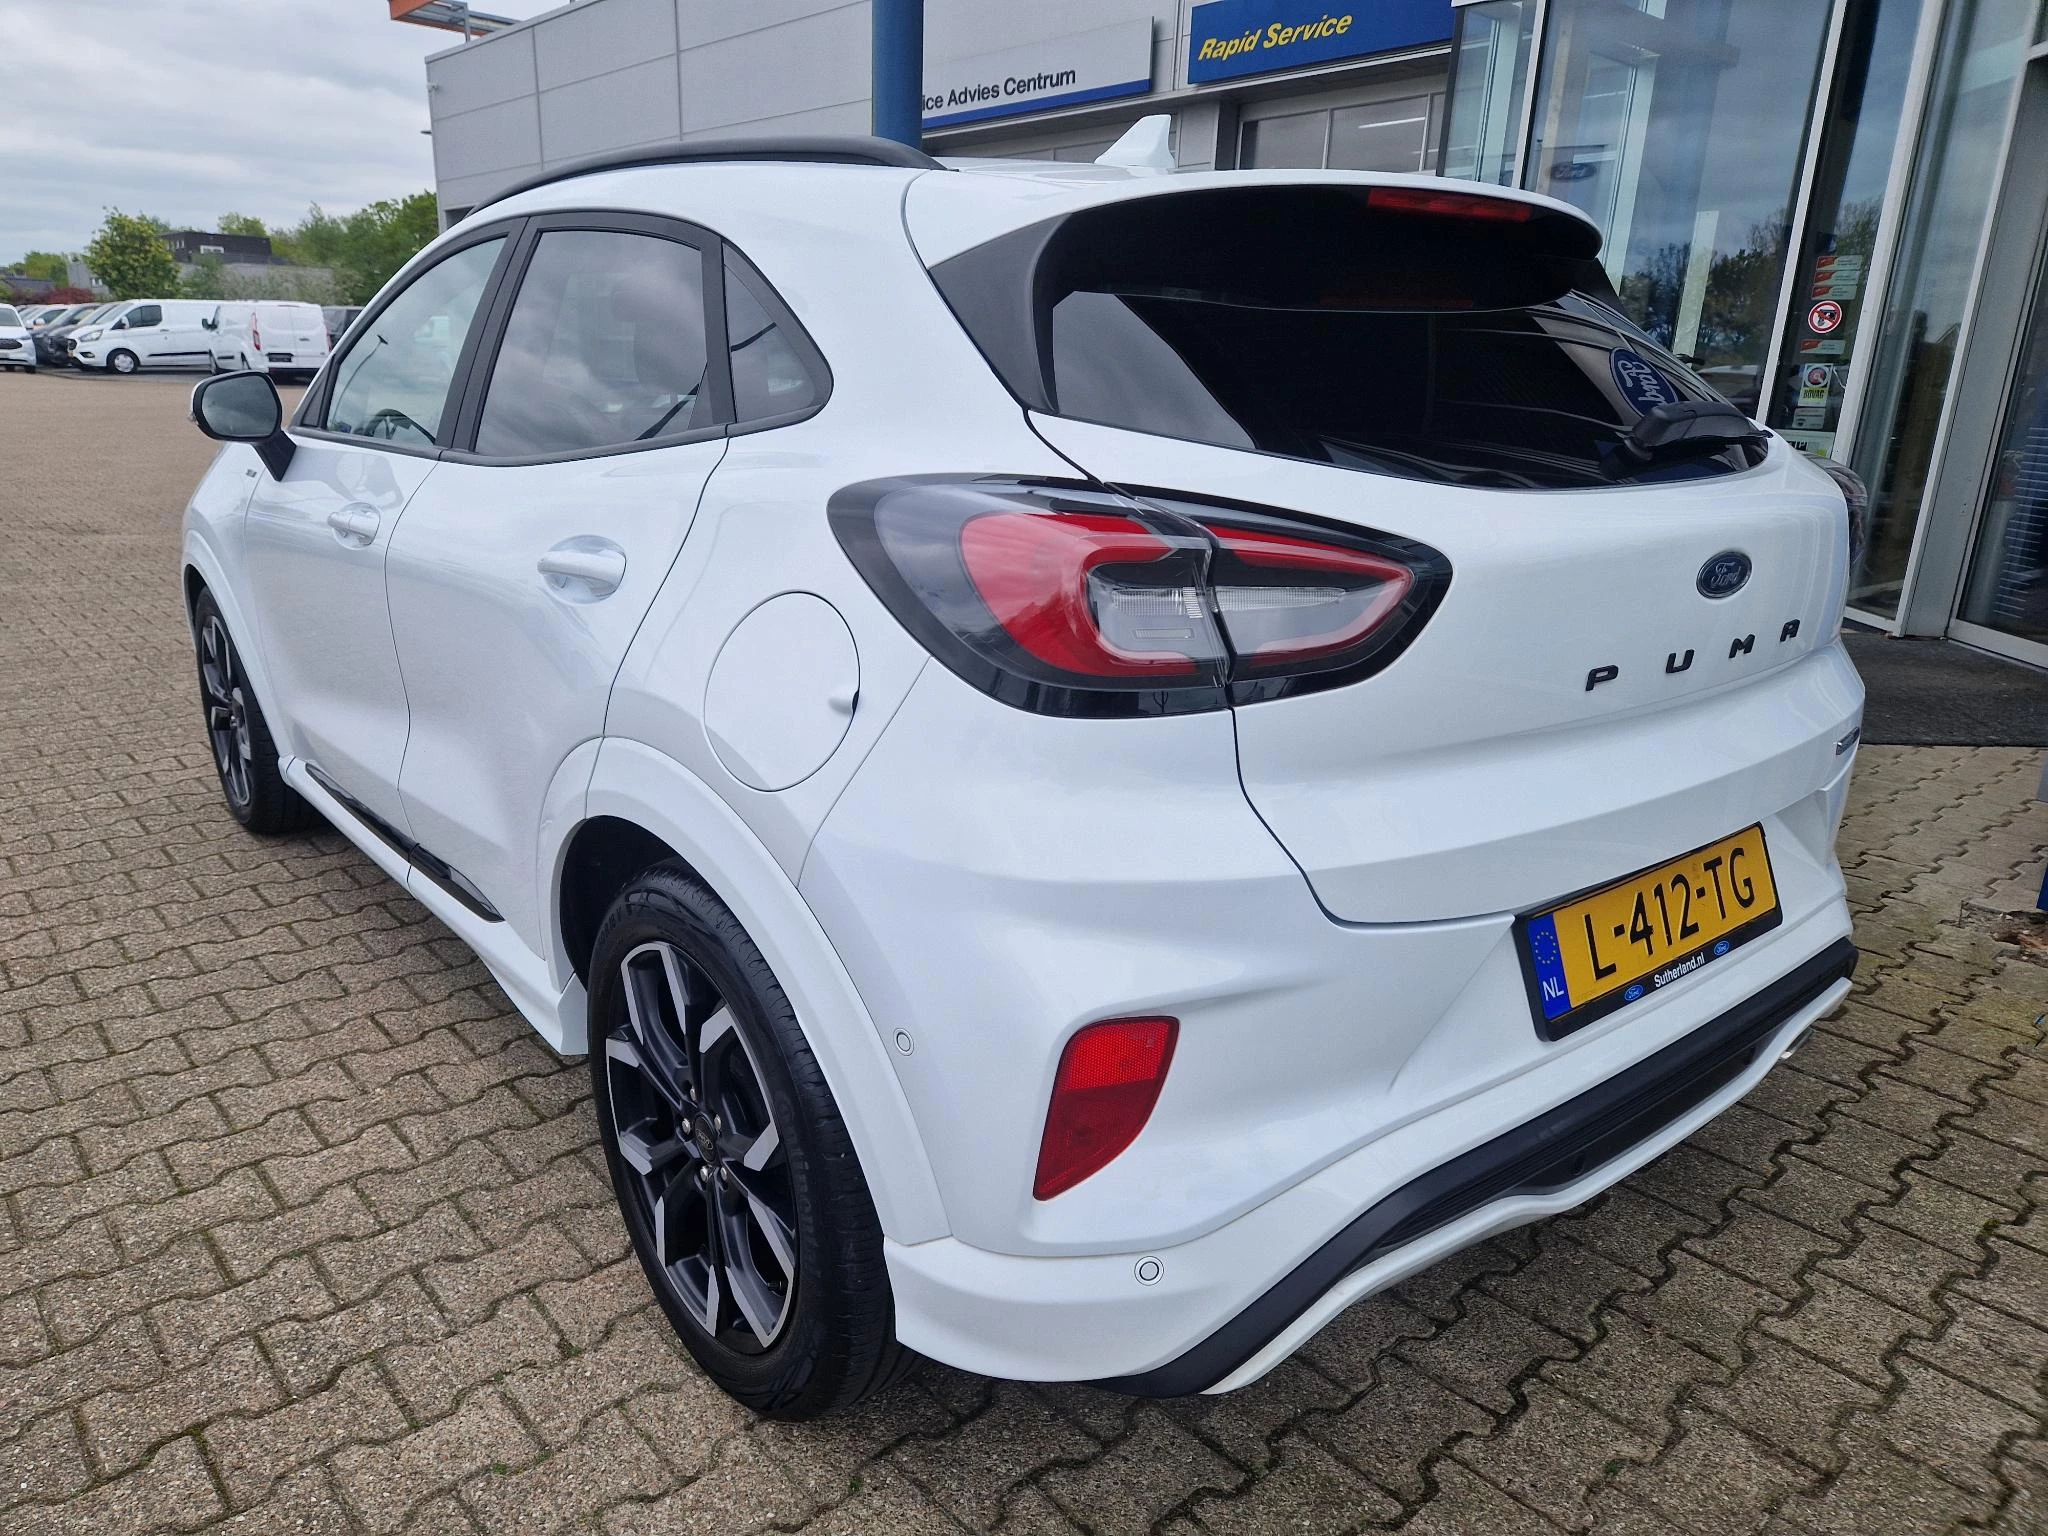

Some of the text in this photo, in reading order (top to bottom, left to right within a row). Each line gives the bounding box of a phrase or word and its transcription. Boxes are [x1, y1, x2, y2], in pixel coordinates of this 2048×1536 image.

[1198, 14, 1353, 61] Rapid Service
[947, 84, 1000, 107] Advies
[1004, 69, 1076, 96] Centrum
[1710, 561, 1741, 589] Ford
[1585, 619, 1800, 691] PUMA
[1584, 848, 1755, 981] L-412-TG
[1542, 976, 1565, 1001] NL
[1654, 952, 1705, 988] Sutherland.nl
